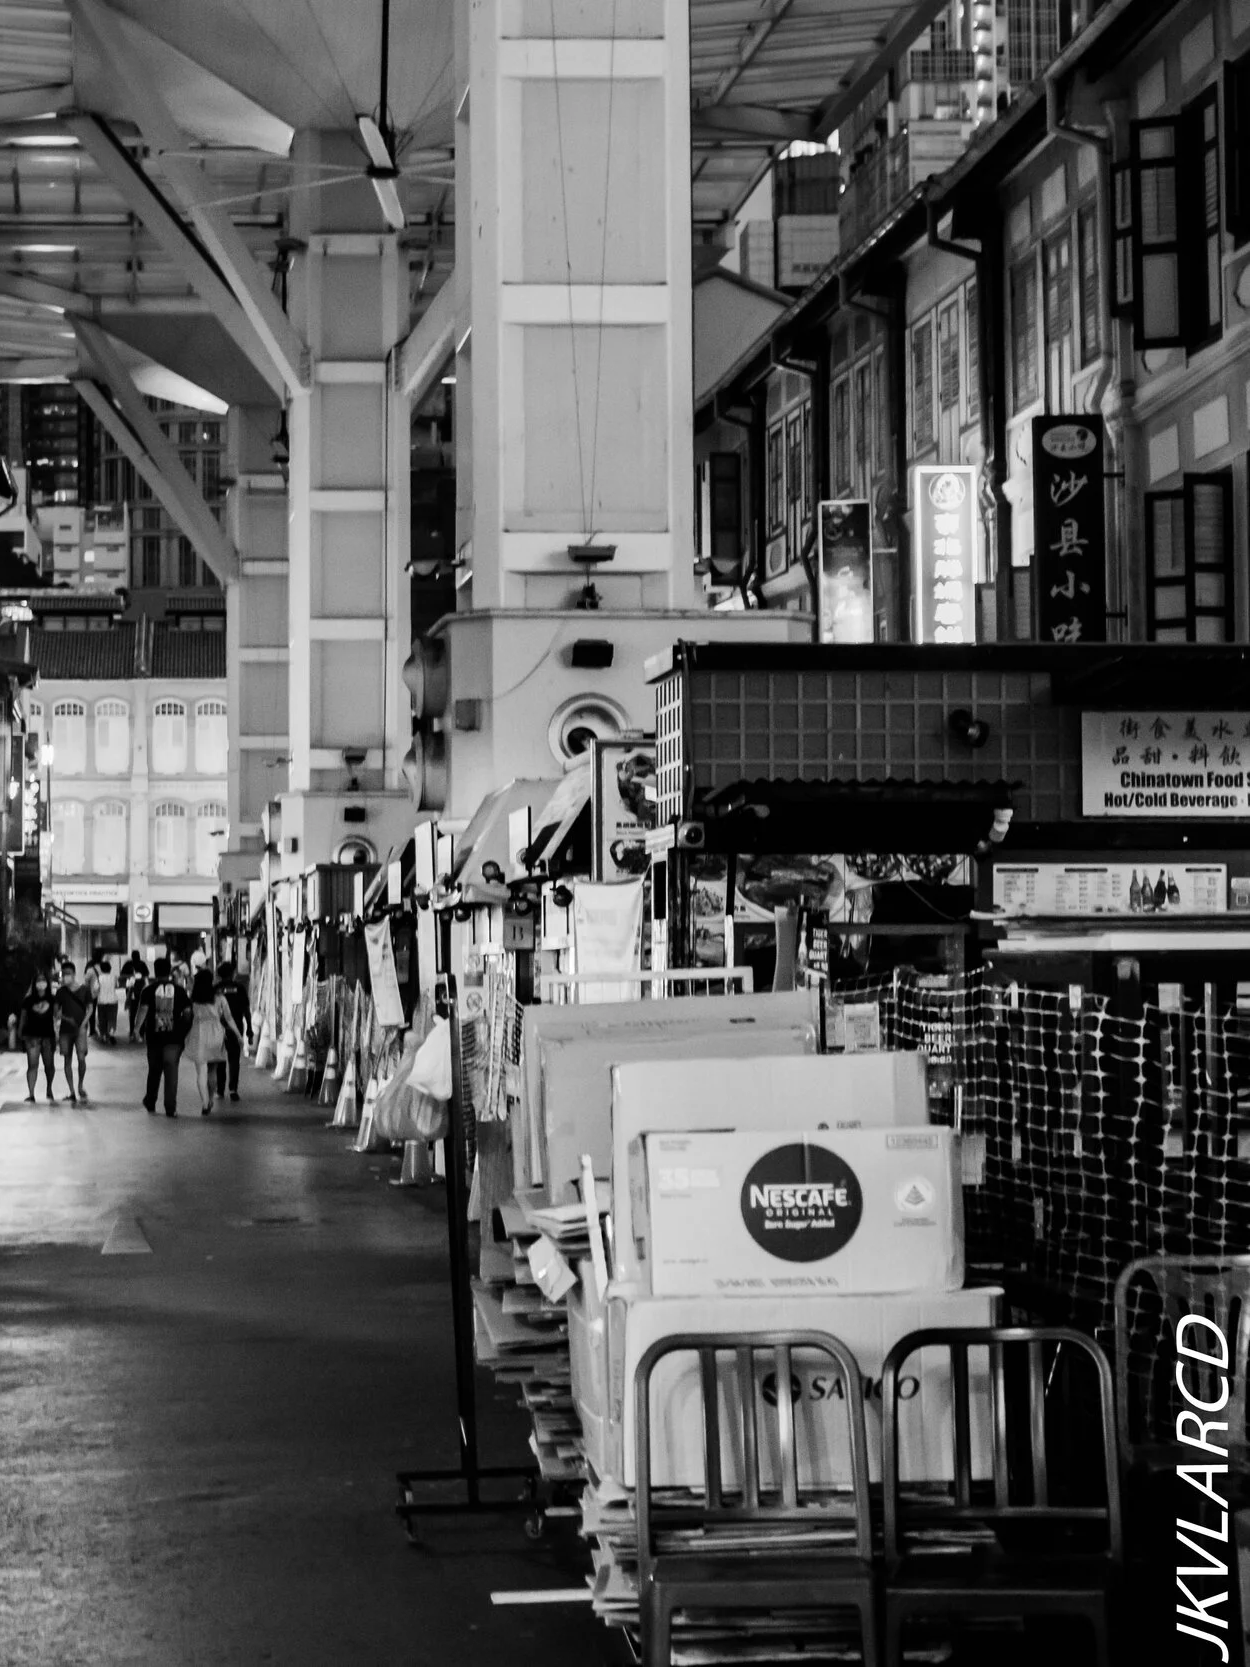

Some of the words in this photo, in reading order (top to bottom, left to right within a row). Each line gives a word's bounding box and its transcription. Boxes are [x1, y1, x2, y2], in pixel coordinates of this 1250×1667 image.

[1120, 771, 1204, 788] Chinatown
[1206, 771, 1244, 788] Food
[1104, 792, 1167, 808] Hot/Cold
[1170, 792, 1238, 809] Beverage
[922, 1021, 952, 1033] TIGER
[924, 1032, 952, 1044] BEER
[917, 1042, 952, 1054] QUART
[765, 1208, 835, 1218] ORIGINAL
[810, 1217, 836, 1229] Added
